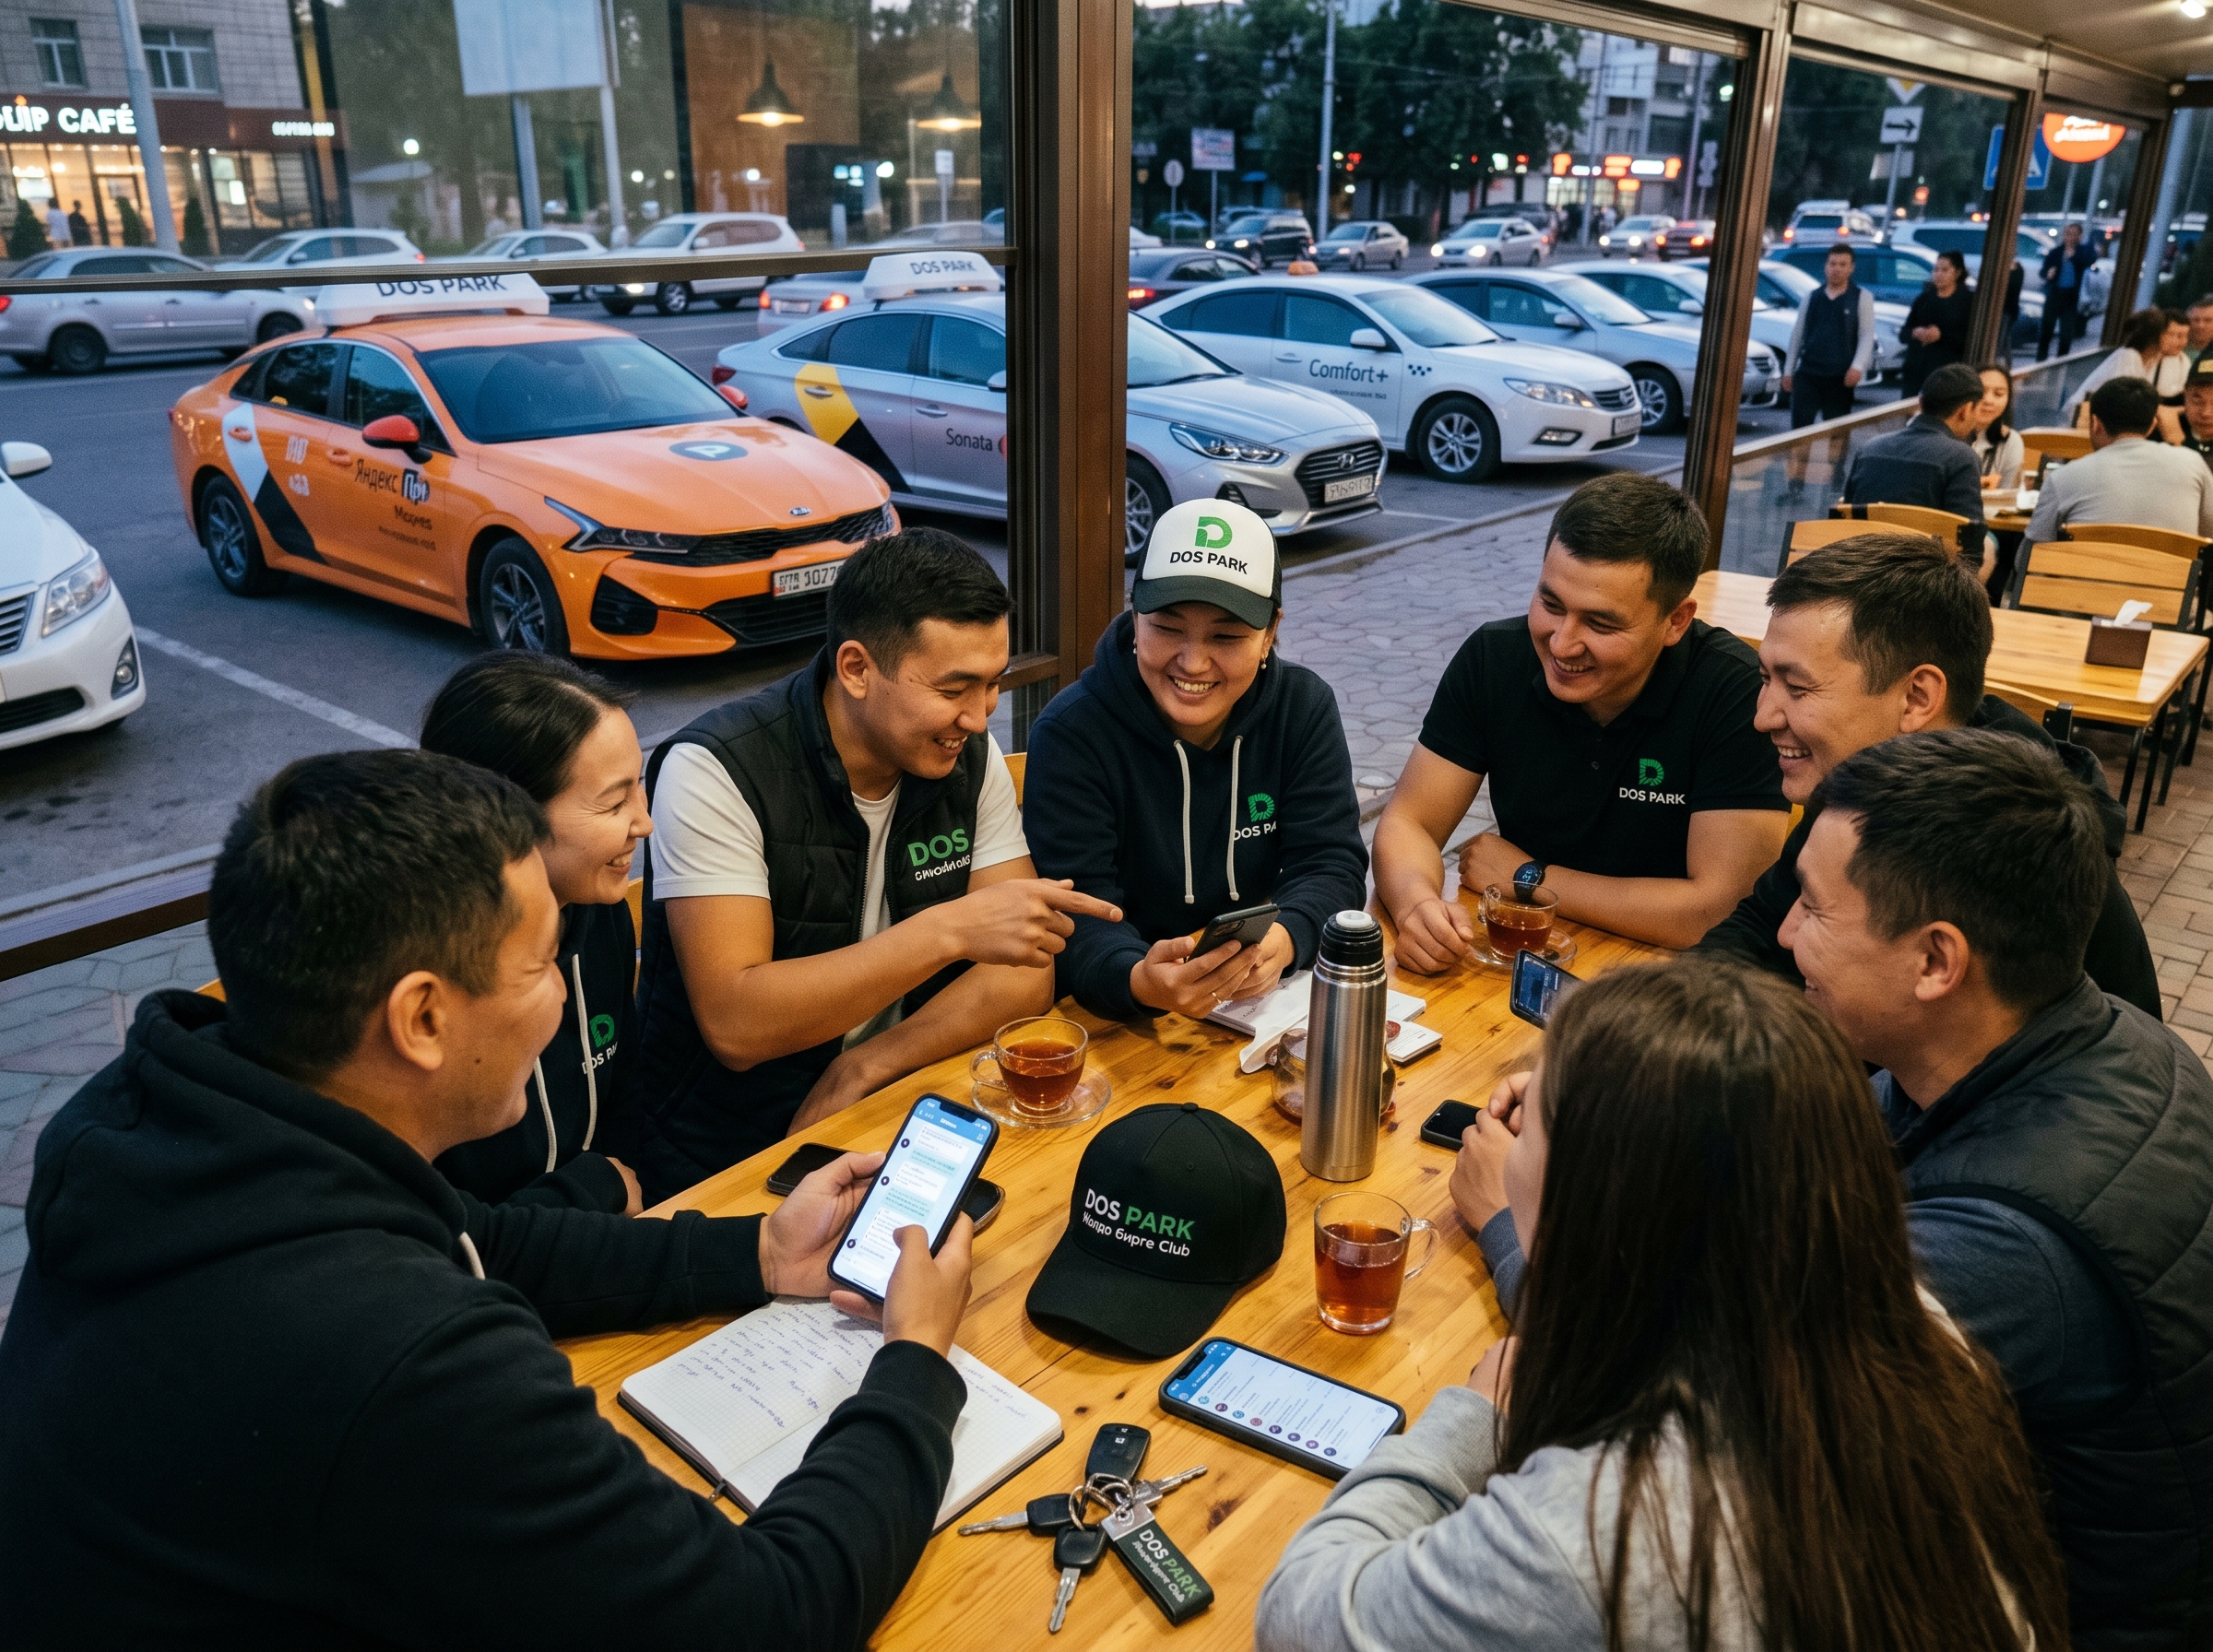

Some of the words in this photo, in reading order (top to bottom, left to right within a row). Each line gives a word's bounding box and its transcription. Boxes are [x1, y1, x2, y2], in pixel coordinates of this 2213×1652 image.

[57, 102, 137, 134] CAFÉ
[909, 261, 941, 275] DOS
[941, 260, 976, 273] PARK
[375, 280, 434, 297] DOS
[440, 276, 506, 293] PARK
[945, 428, 993, 452] Sonata
[1169, 550, 1203, 564] DOS
[1207, 552, 1249, 575] PARK
[1618, 787, 1646, 801] DOS
[1649, 791, 1686, 805] PARK
[907, 828, 969, 867] DOS
[1084, 1187, 1121, 1221] DOS
[1125, 1206, 1196, 1241] PARK
[1115, 1228, 1154, 1249] бирге
[1158, 1240, 1190, 1257] Club
[1139, 1529, 1169, 1560] DOS
[1162, 1558, 1201, 1598] PARK
